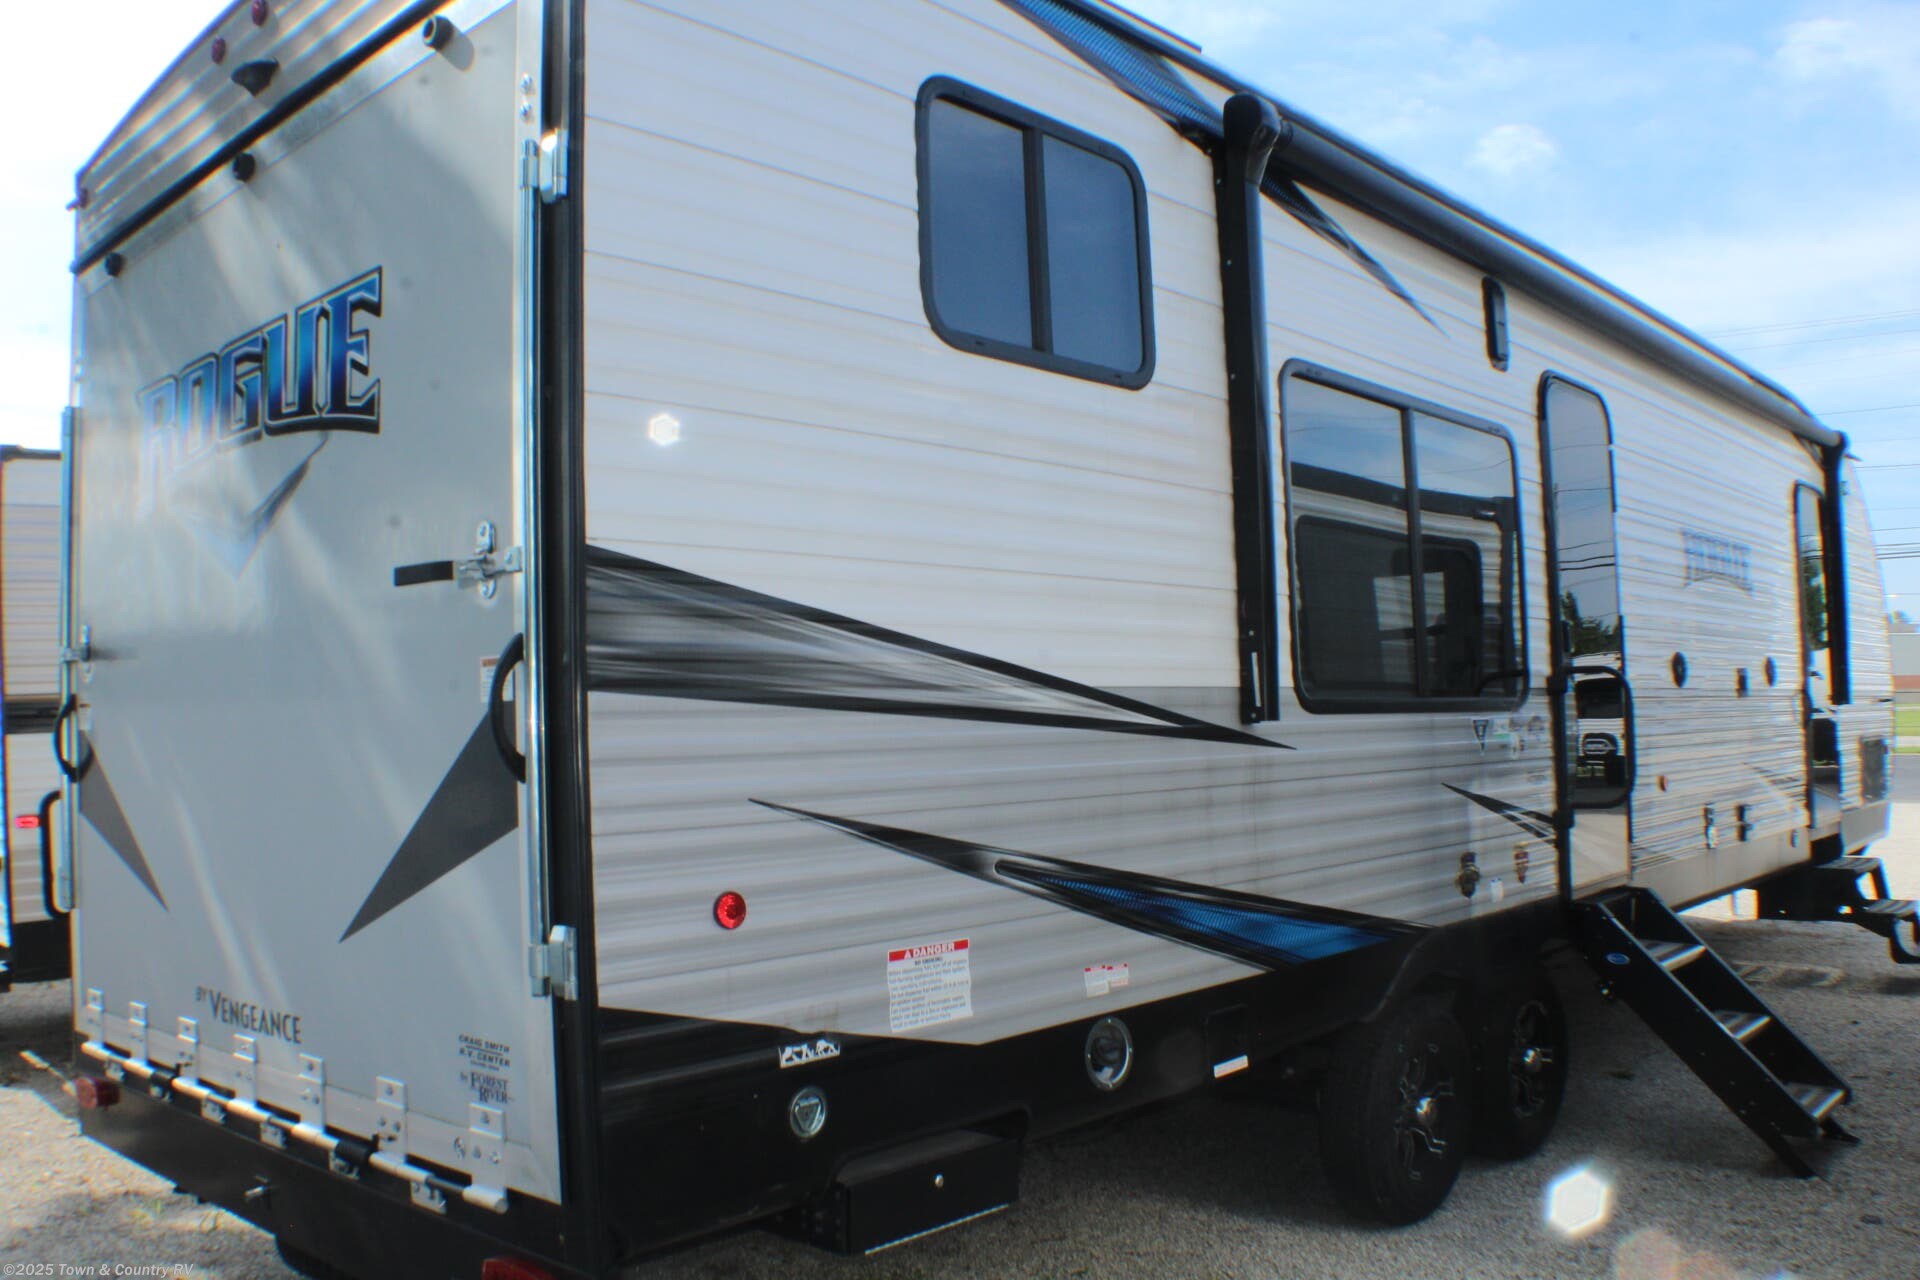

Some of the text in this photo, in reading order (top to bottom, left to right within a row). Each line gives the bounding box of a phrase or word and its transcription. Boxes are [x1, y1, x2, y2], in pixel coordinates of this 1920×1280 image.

[136, 264, 383, 492] ROGUE
[913, 942, 955, 957] DANGER
[209, 988, 302, 1045] VENGEANCE
